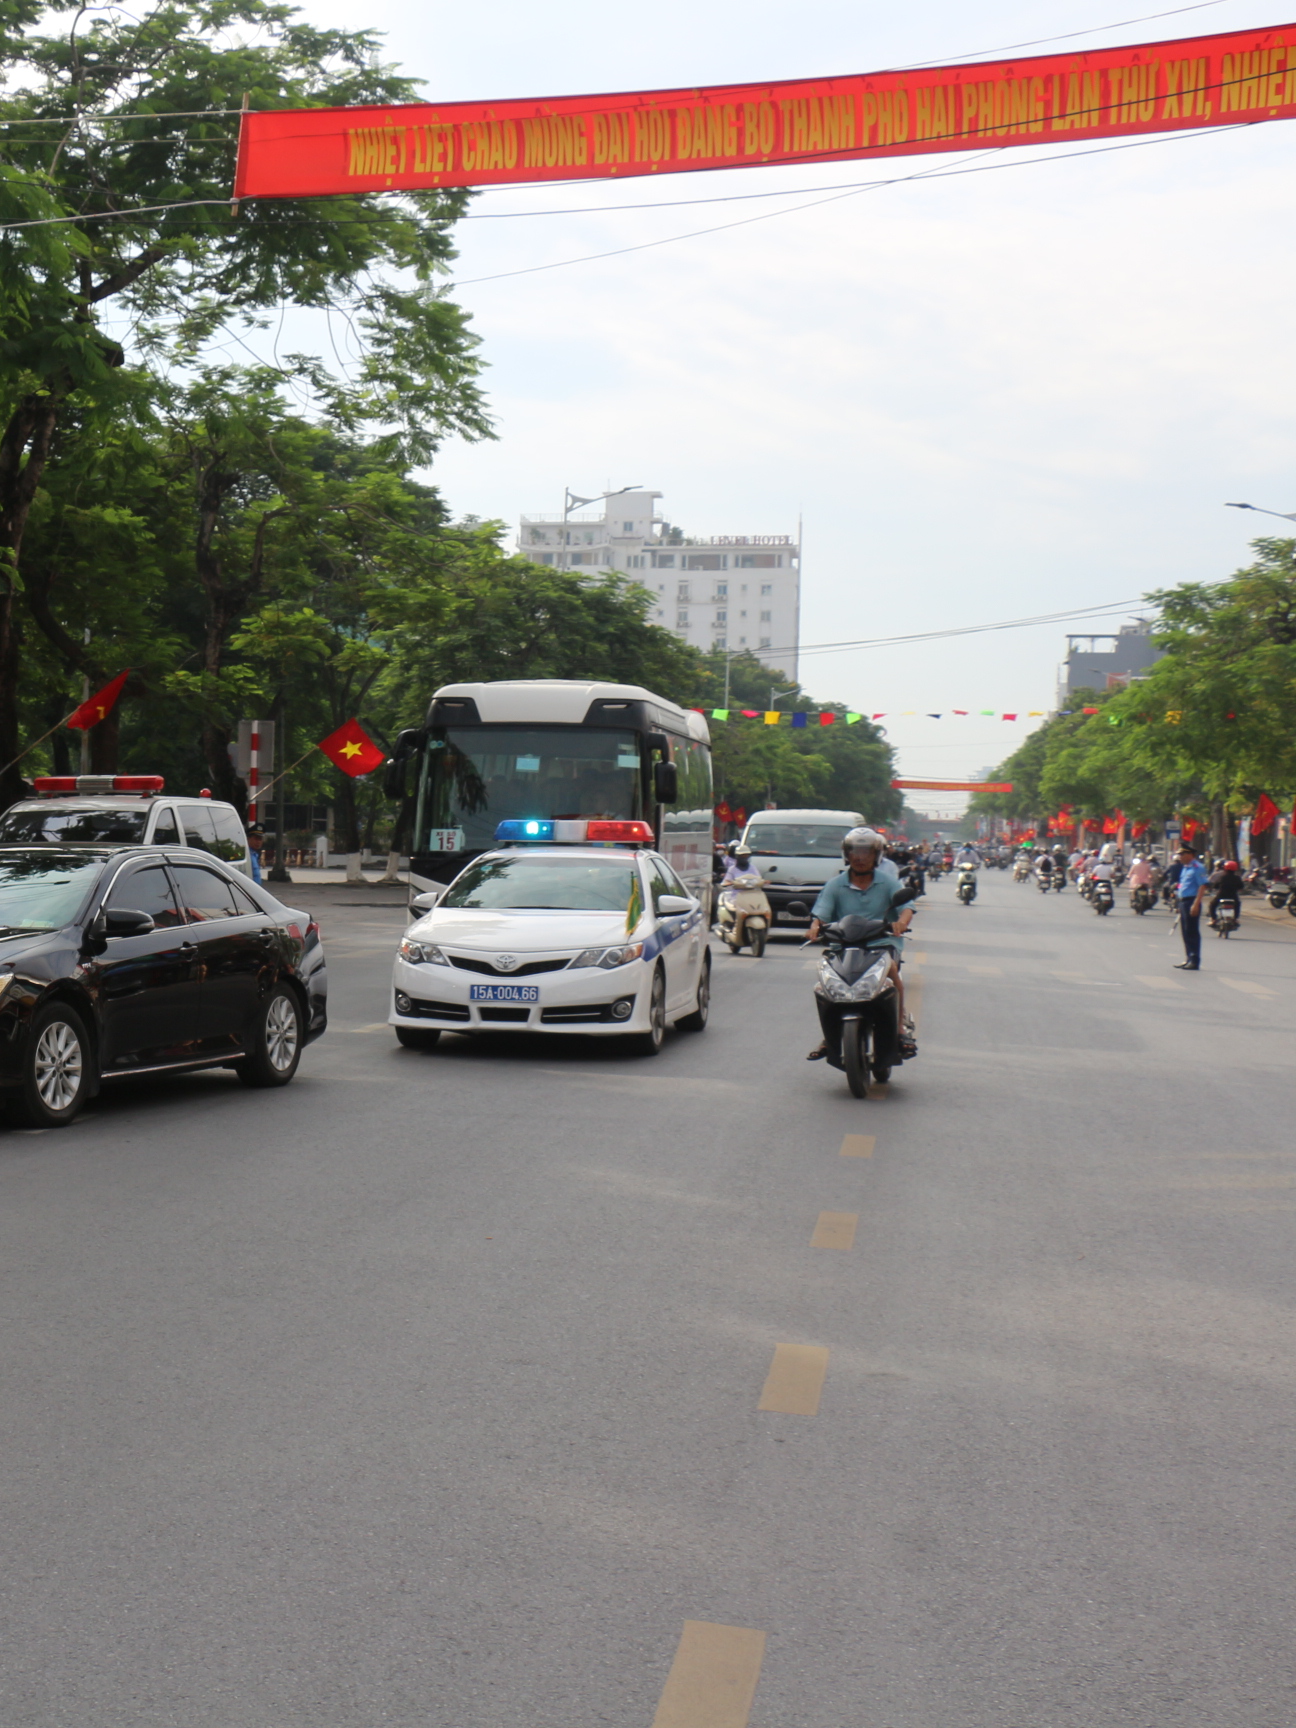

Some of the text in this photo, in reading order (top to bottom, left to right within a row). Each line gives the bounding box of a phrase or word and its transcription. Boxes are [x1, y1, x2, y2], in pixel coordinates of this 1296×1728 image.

[349, 115, 407, 186] NHIỆT
[413, 113, 455, 183] LIỆT
[461, 109, 518, 172] CHÀO
[522, 104, 588, 168] MỪNG
[593, 112, 630, 173] ĐẠI
[633, 101, 670, 172] HỘI
[676, 89, 738, 160] ĐẢNG
[743, 90, 774, 162] BỘ
[781, 87, 855, 152] THÀNH
[862, 73, 909, 147] PHỐ
[915, 68, 955, 143] HẢI
[961, 68, 1045, 138] PHÒNG
[1051, 55, 1101, 131] LẦN
[1108, 49, 1160, 125] THỨ
[753, 535, 794, 546] HOTEL
[438, 837, 455, 850] 15
[472, 985, 538, 1001] 15A-004.66
